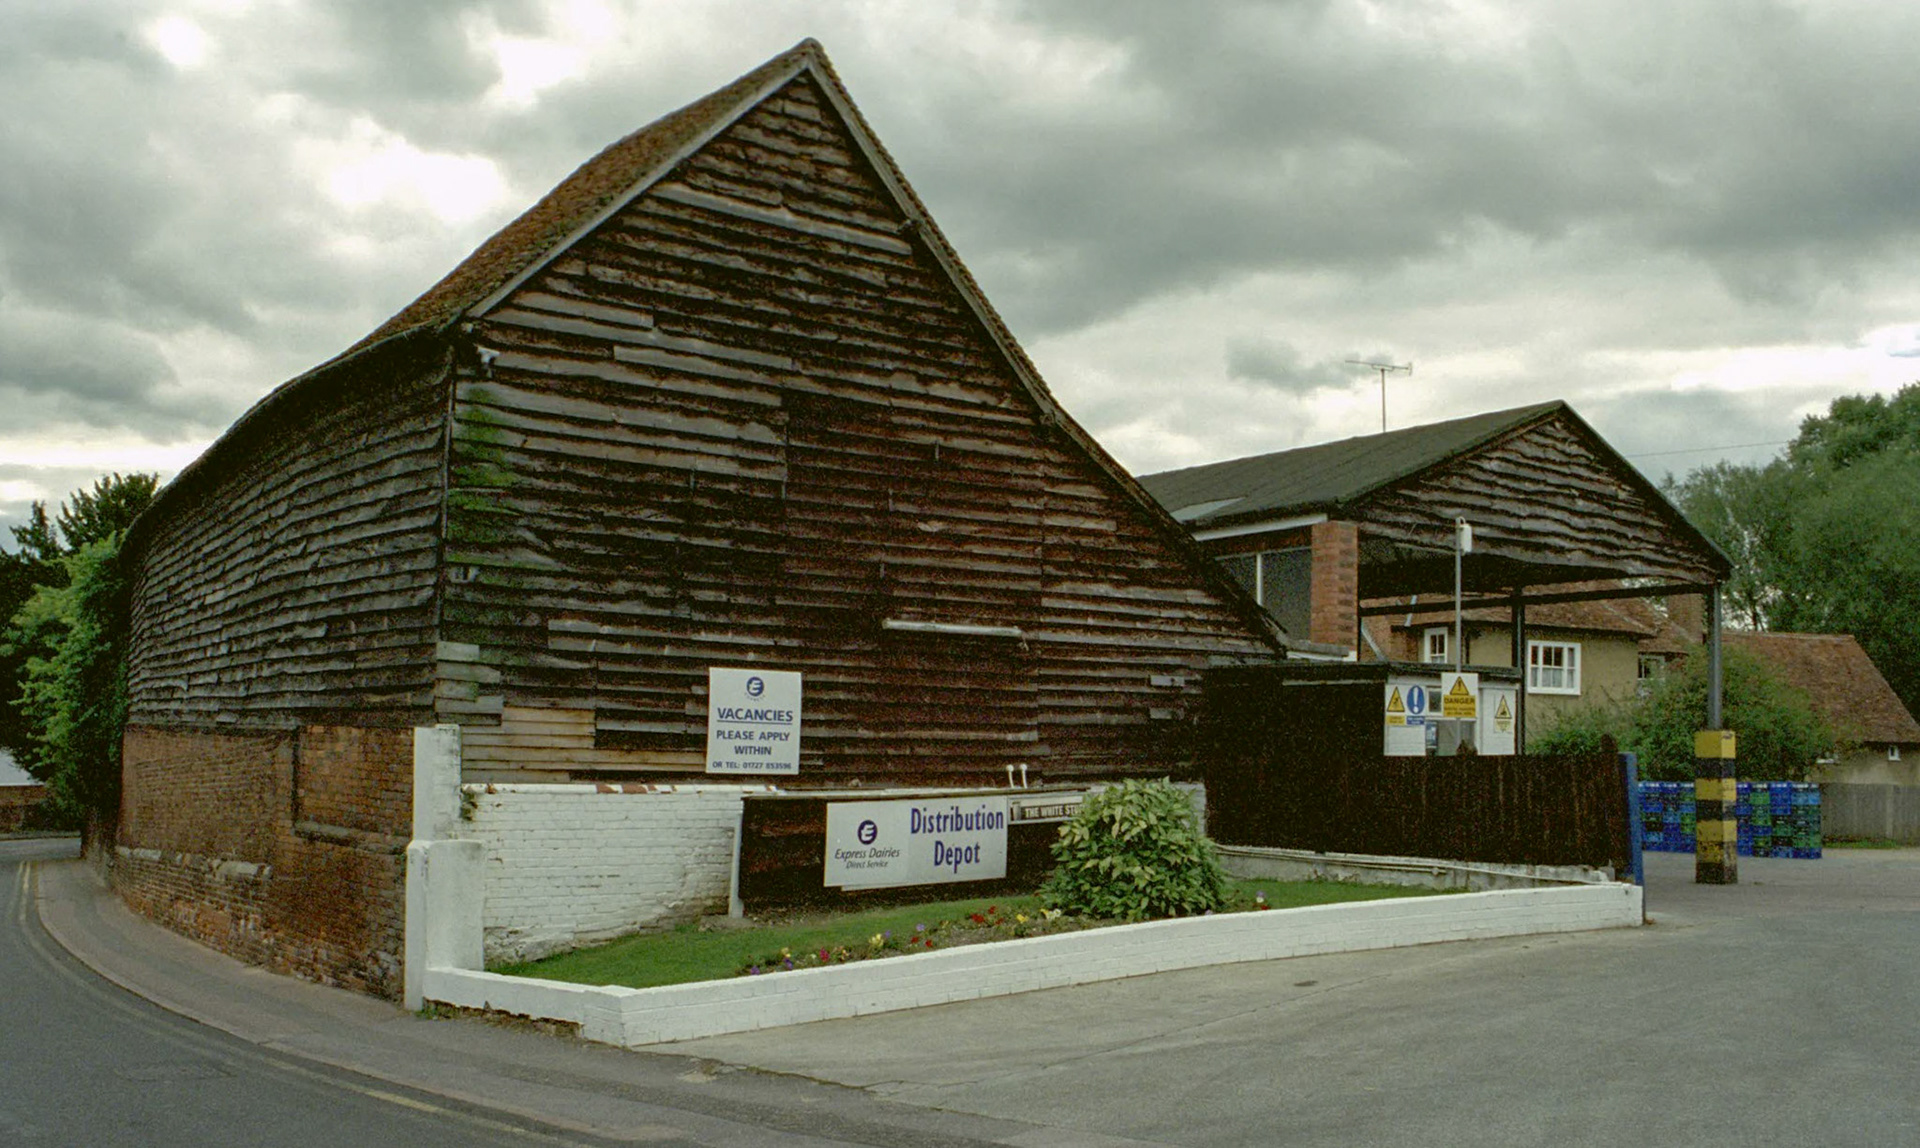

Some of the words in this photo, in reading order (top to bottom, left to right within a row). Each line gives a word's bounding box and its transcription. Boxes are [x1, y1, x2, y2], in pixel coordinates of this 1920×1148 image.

[1443, 697, 1475, 705] DANGER
[717, 707, 793, 722] VACANCIES
[716, 730, 754, 740] PLEASE
[759, 731, 790, 741] APPLY
[734, 745, 772, 755] WITHIN
[726, 761, 740, 769] TEL:
[1025, 807, 1040, 819] THE
[1041, 805, 1064, 818] WHITE
[911, 804, 1004, 834] Distribution
[834, 848, 867, 861] Express
[868, 847, 900, 858] Dairies
[934, 840, 981, 874] Depot
[845, 860, 866, 869] Direct
[866, 860, 889, 868] Service
